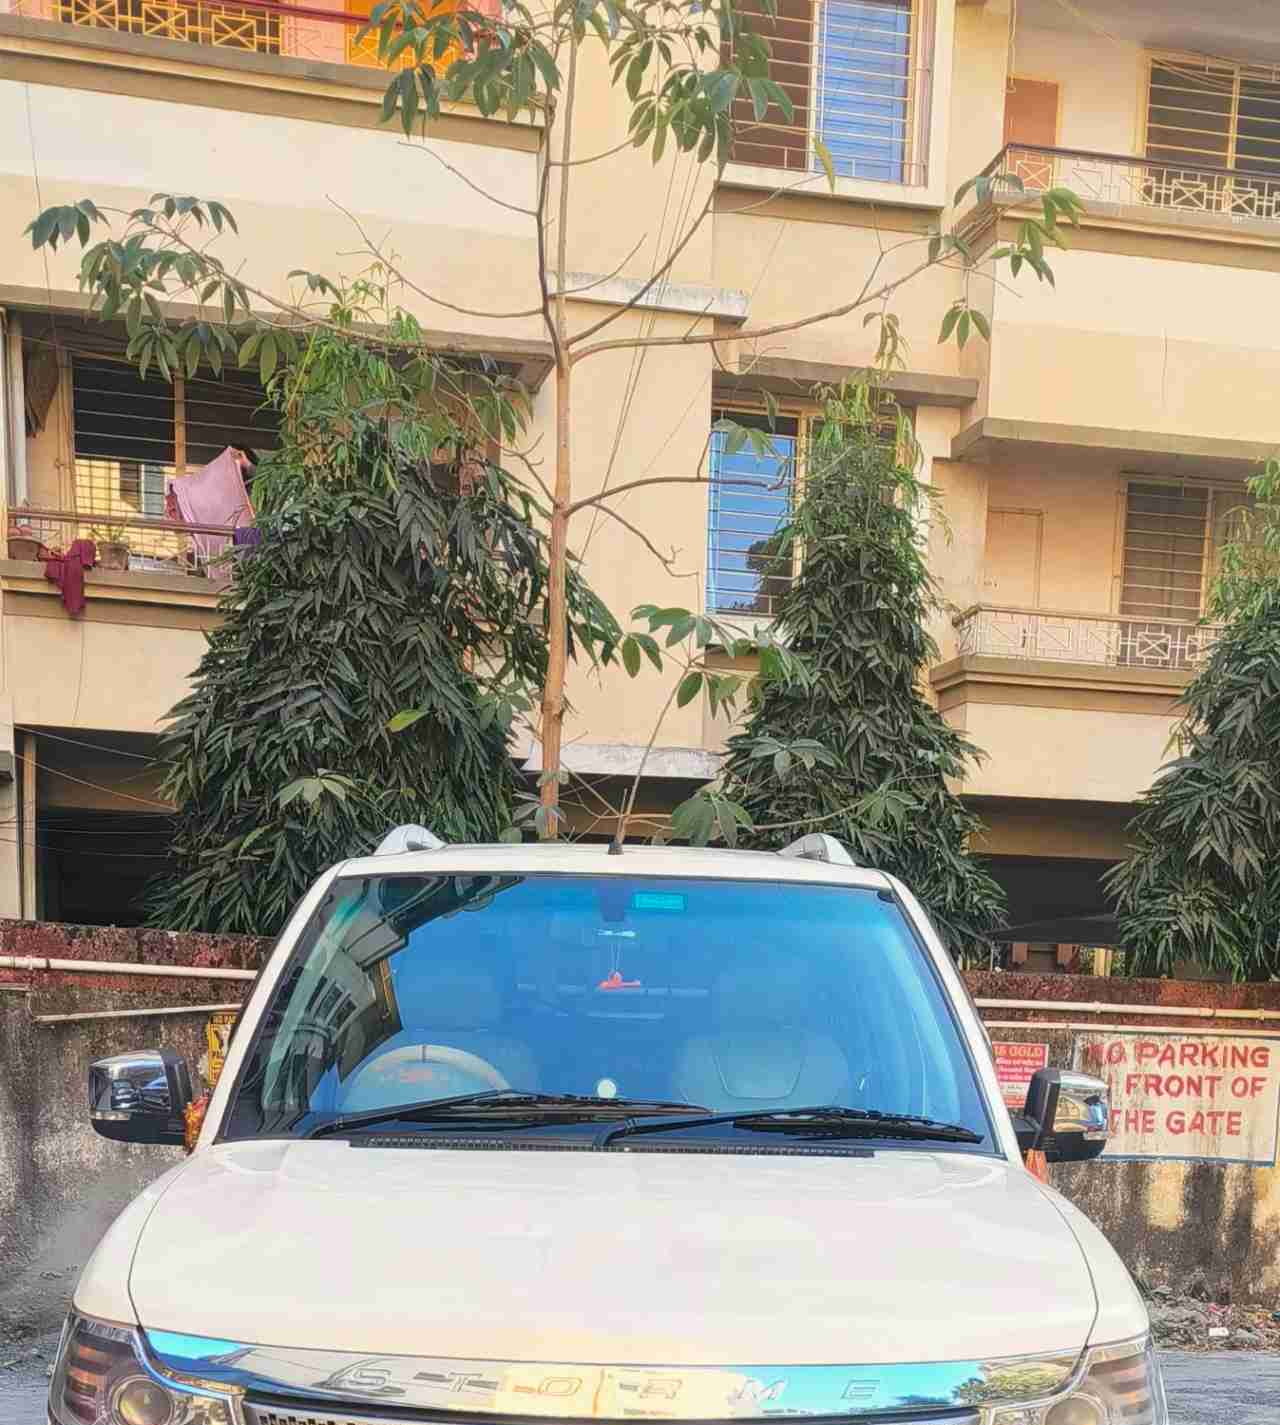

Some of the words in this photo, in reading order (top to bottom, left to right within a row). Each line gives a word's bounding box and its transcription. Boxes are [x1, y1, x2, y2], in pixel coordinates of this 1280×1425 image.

[1135, 1041, 1270, 1068] PARKING
[1126, 1073, 1222, 1098] FRONT
[1231, 1075, 1267, 1098] OF
[1109, 1109, 1156, 1135] THE
[1165, 1110, 1242, 1136] GATE
